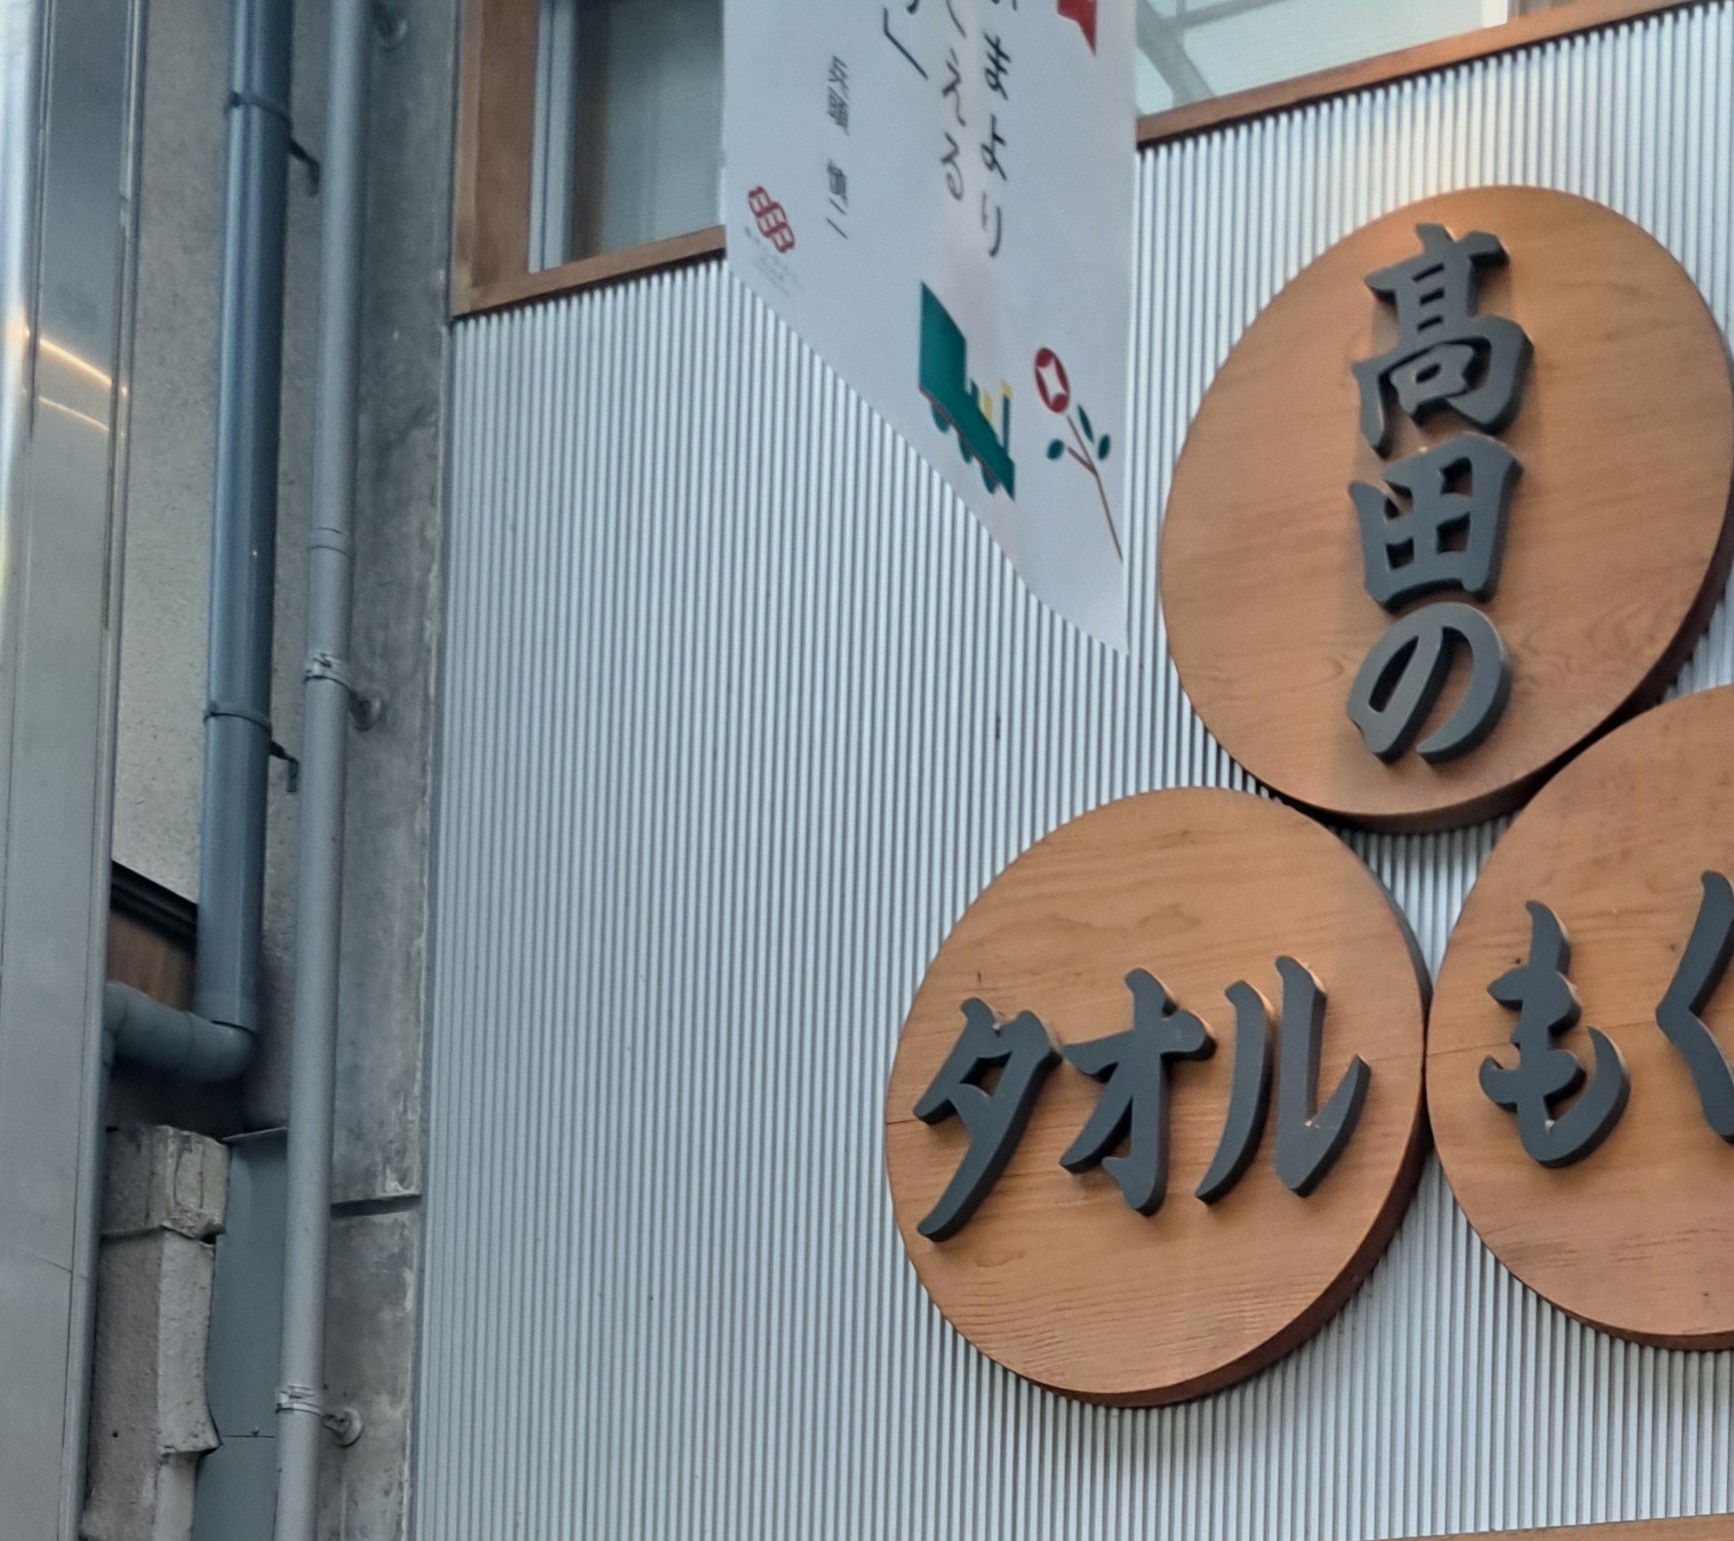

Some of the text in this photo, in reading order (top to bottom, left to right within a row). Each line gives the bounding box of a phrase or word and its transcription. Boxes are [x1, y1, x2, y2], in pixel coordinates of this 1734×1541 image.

[980, 0, 1014, 258] まより
[914, 954, 1373, 1243] タオル
